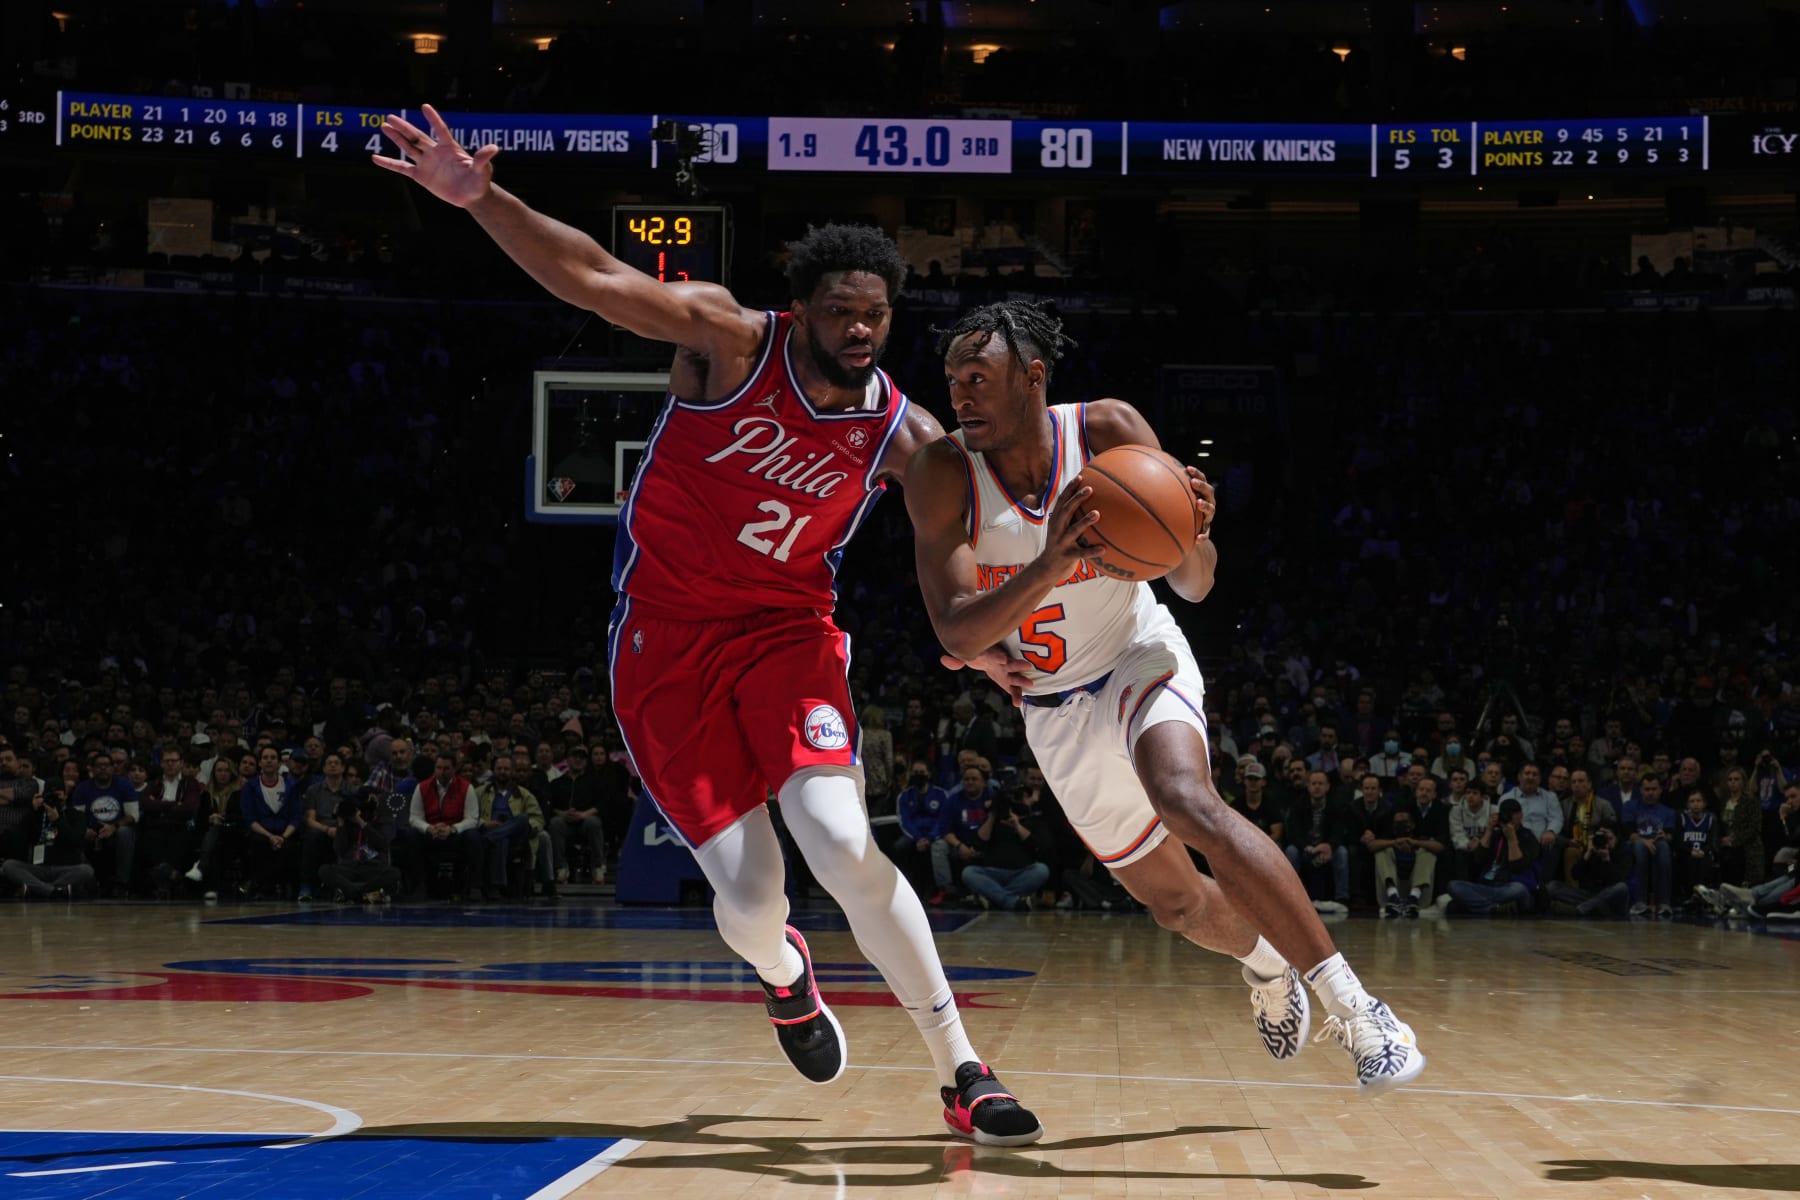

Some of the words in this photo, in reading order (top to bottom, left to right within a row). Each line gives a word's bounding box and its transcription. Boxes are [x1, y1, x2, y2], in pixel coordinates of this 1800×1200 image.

[19, 111, 45, 123] 3RD
[71, 102, 132, 118] PLAYER
[144, 105, 162, 120] 21
[181, 108, 189, 122] 1
[204, 108, 227, 123] 20
[238, 110, 256, 125] 14
[268, 112, 287, 127] 18
[316, 112, 342, 126] FLS
[71, 124, 132, 140] POINTS
[142, 128, 163, 142] 23
[174, 129, 193, 144] 21
[210, 131, 220, 146] 6
[241, 133, 252, 147] 6
[272, 134, 283, 149] 6
[321, 131, 338, 152] 4
[365, 133, 382, 154] 4
[564, 130, 628, 152] 76ERS
[779, 133, 816, 157] 1.9
[855, 125, 950, 166] 43.0
[962, 137, 998, 156] 3RD
[1041, 128, 1092, 168] 80
[1390, 130, 1416, 143] FLS
[1431, 129, 1460, 142] TOL
[1485, 130, 1543, 145] PLAYER
[1557, 129, 1569, 142] 9
[1582, 129, 1603, 142] 45
[1617, 128, 1628, 141] 5
[1644, 127, 1663, 141] 21
[1680, 126, 1688, 140] 1
[1164, 139, 1202, 160] NEW
[1208, 140, 1255, 160] YORK
[1264, 140, 1335, 161] KNICKS
[1395, 149, 1410, 169] 5
[1438, 148, 1453, 168] 3
[1485, 151, 1543, 167] POINTS
[1552, 151, 1573, 165] 22
[1587, 150, 1598, 164] 2
[1618, 149, 1629, 163] 9
[1647, 149, 1658, 162] 5
[1679, 148, 1688, 162] 3
[629, 216, 692, 245] 42.9
[704, 416, 848, 498] Phila
[832, 439, 864, 465] crypto.com
[736, 499, 812, 562] 21
[977, 563, 1024, 591] NE
[1018, 602, 1067, 675] 5
